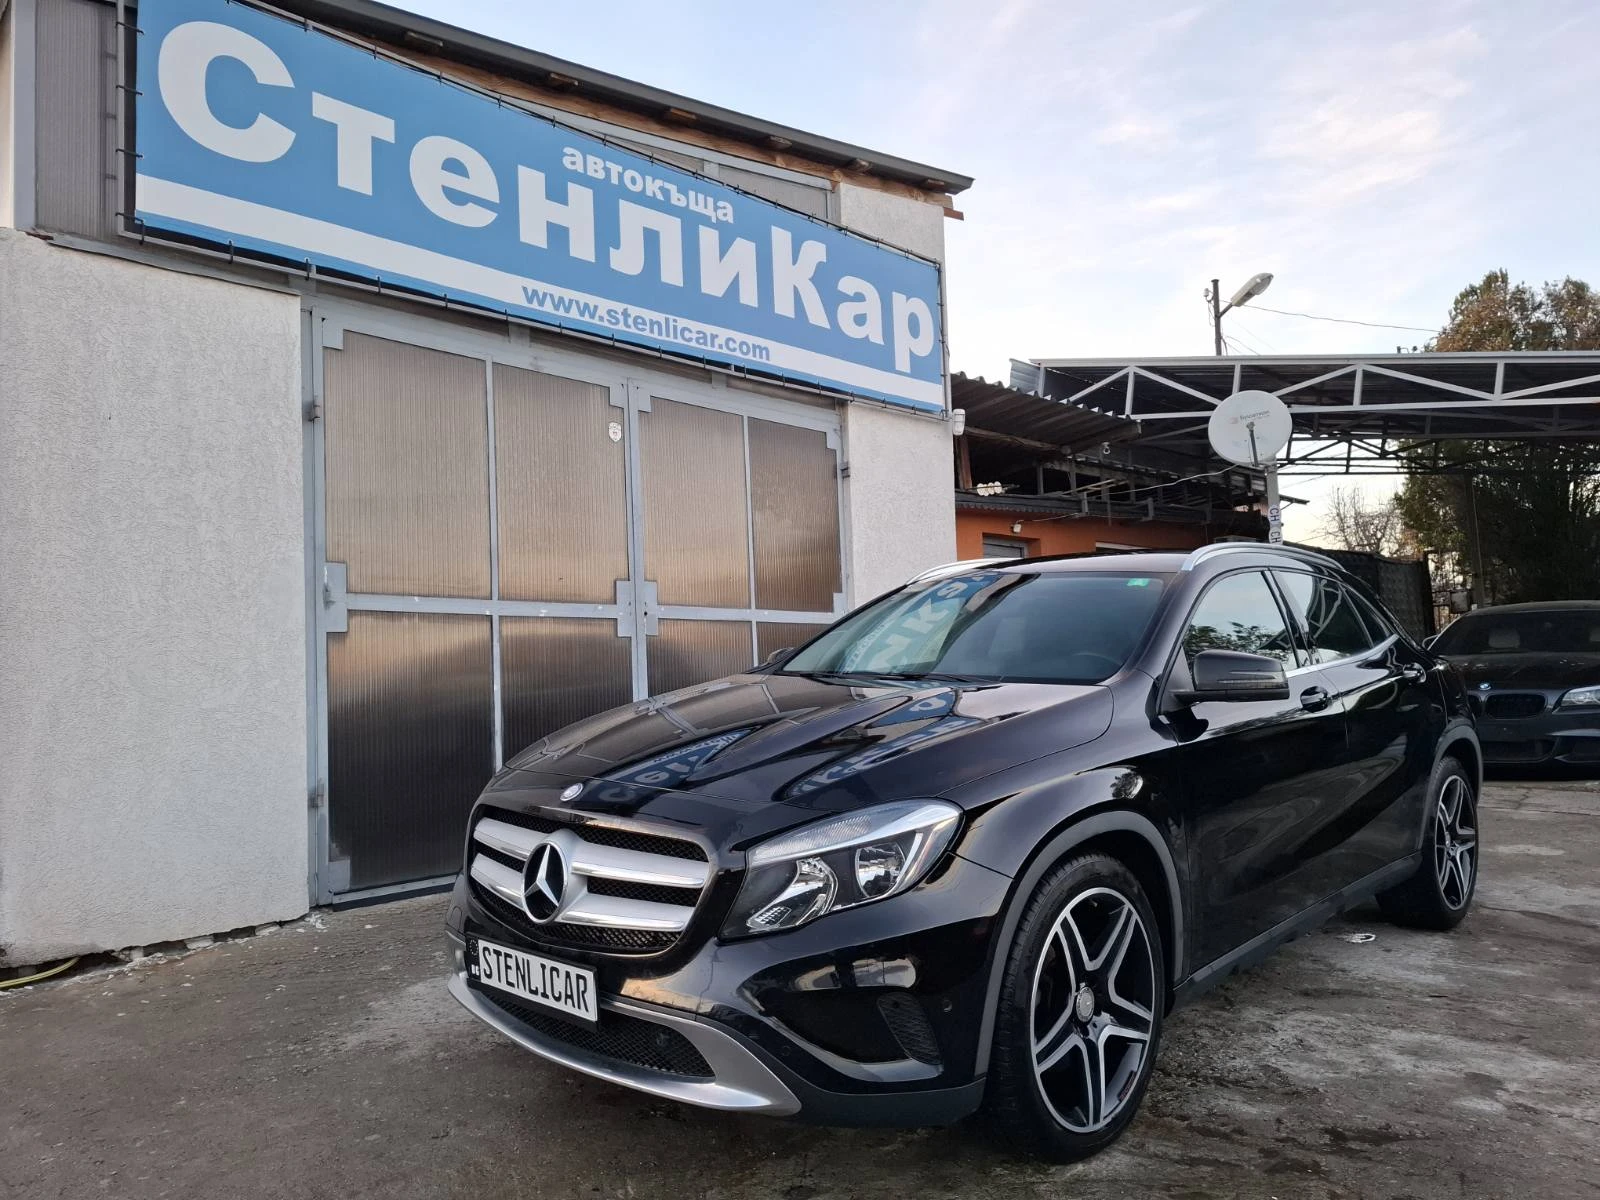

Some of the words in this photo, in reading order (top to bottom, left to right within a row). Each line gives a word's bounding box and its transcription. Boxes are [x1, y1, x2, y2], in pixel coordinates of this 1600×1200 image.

[158, 21, 935, 373] СтенлиКар
[562, 146, 734, 224] автокъща
[522, 286, 770, 361] www.stenlicar.com
[482, 946, 589, 1013] STENLICAR
